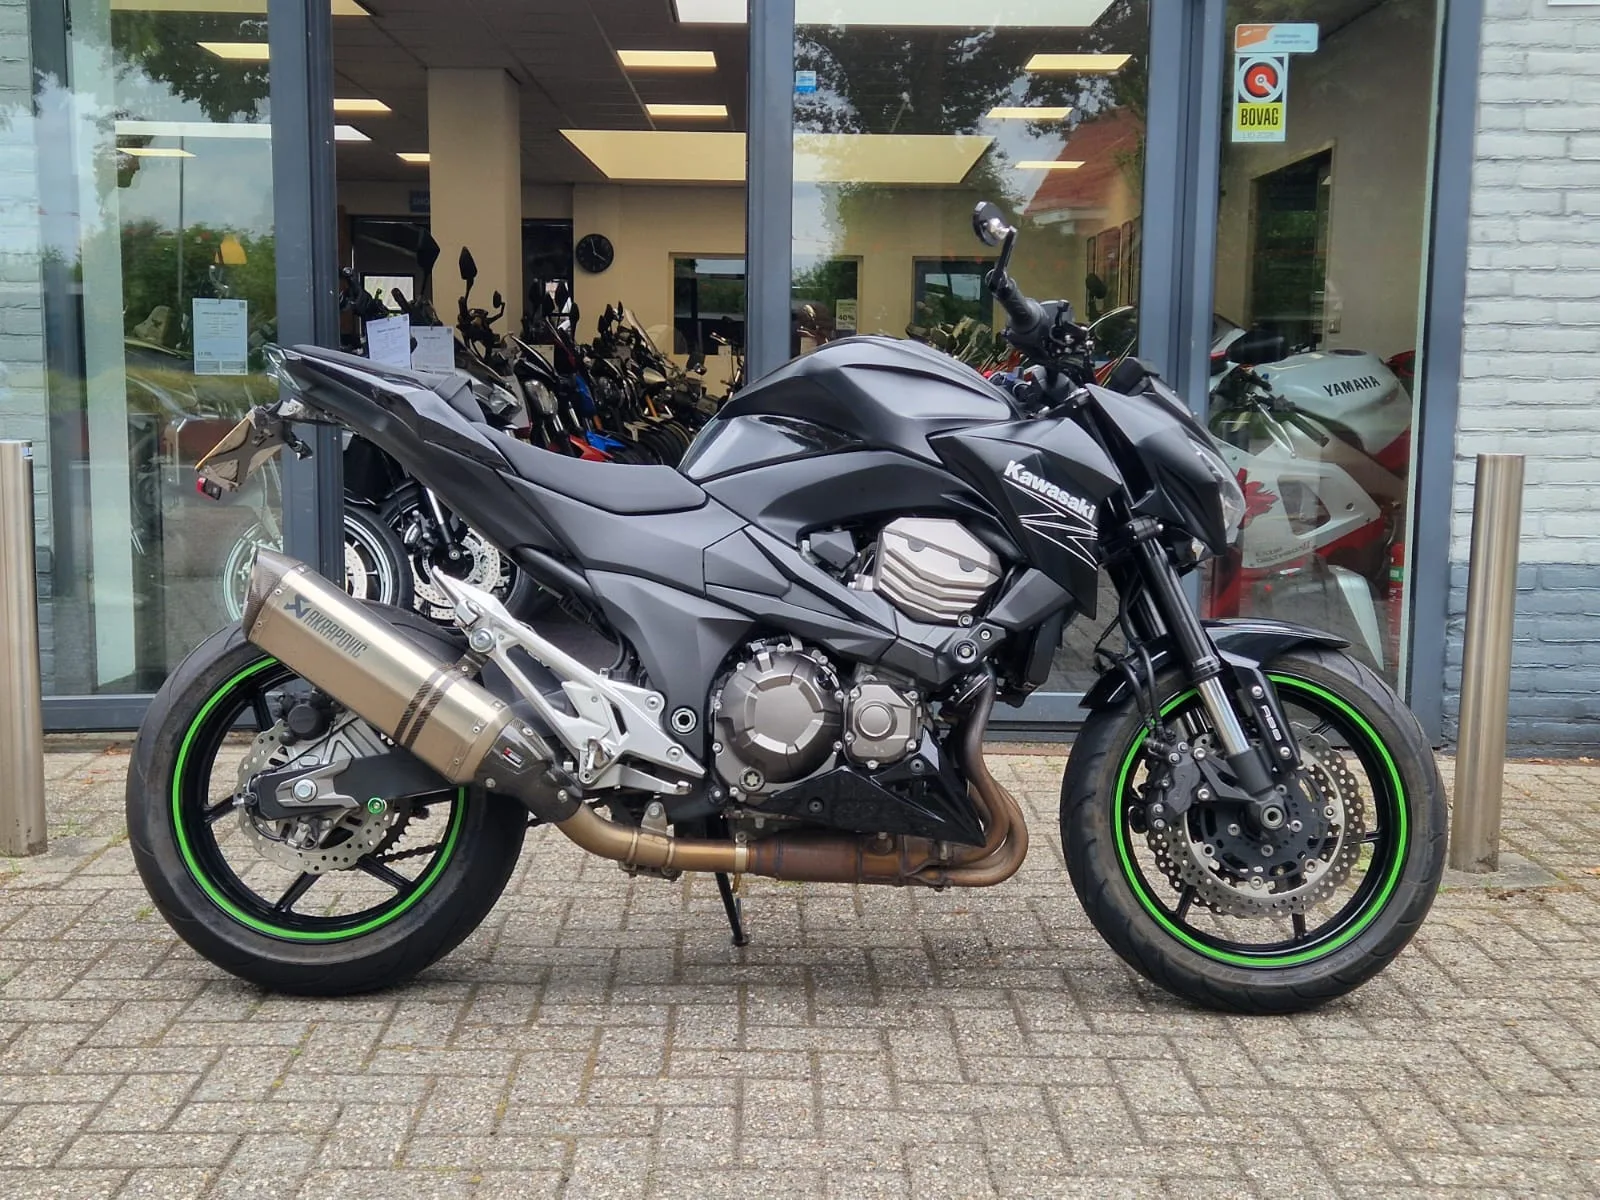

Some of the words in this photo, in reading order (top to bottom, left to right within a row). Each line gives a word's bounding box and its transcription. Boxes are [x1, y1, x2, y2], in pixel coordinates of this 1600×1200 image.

[1241, 107, 1279, 126] BOVAG
[1323, 375, 1381, 397] YAMAHA
[1003, 460, 1097, 521] Kawasaki
